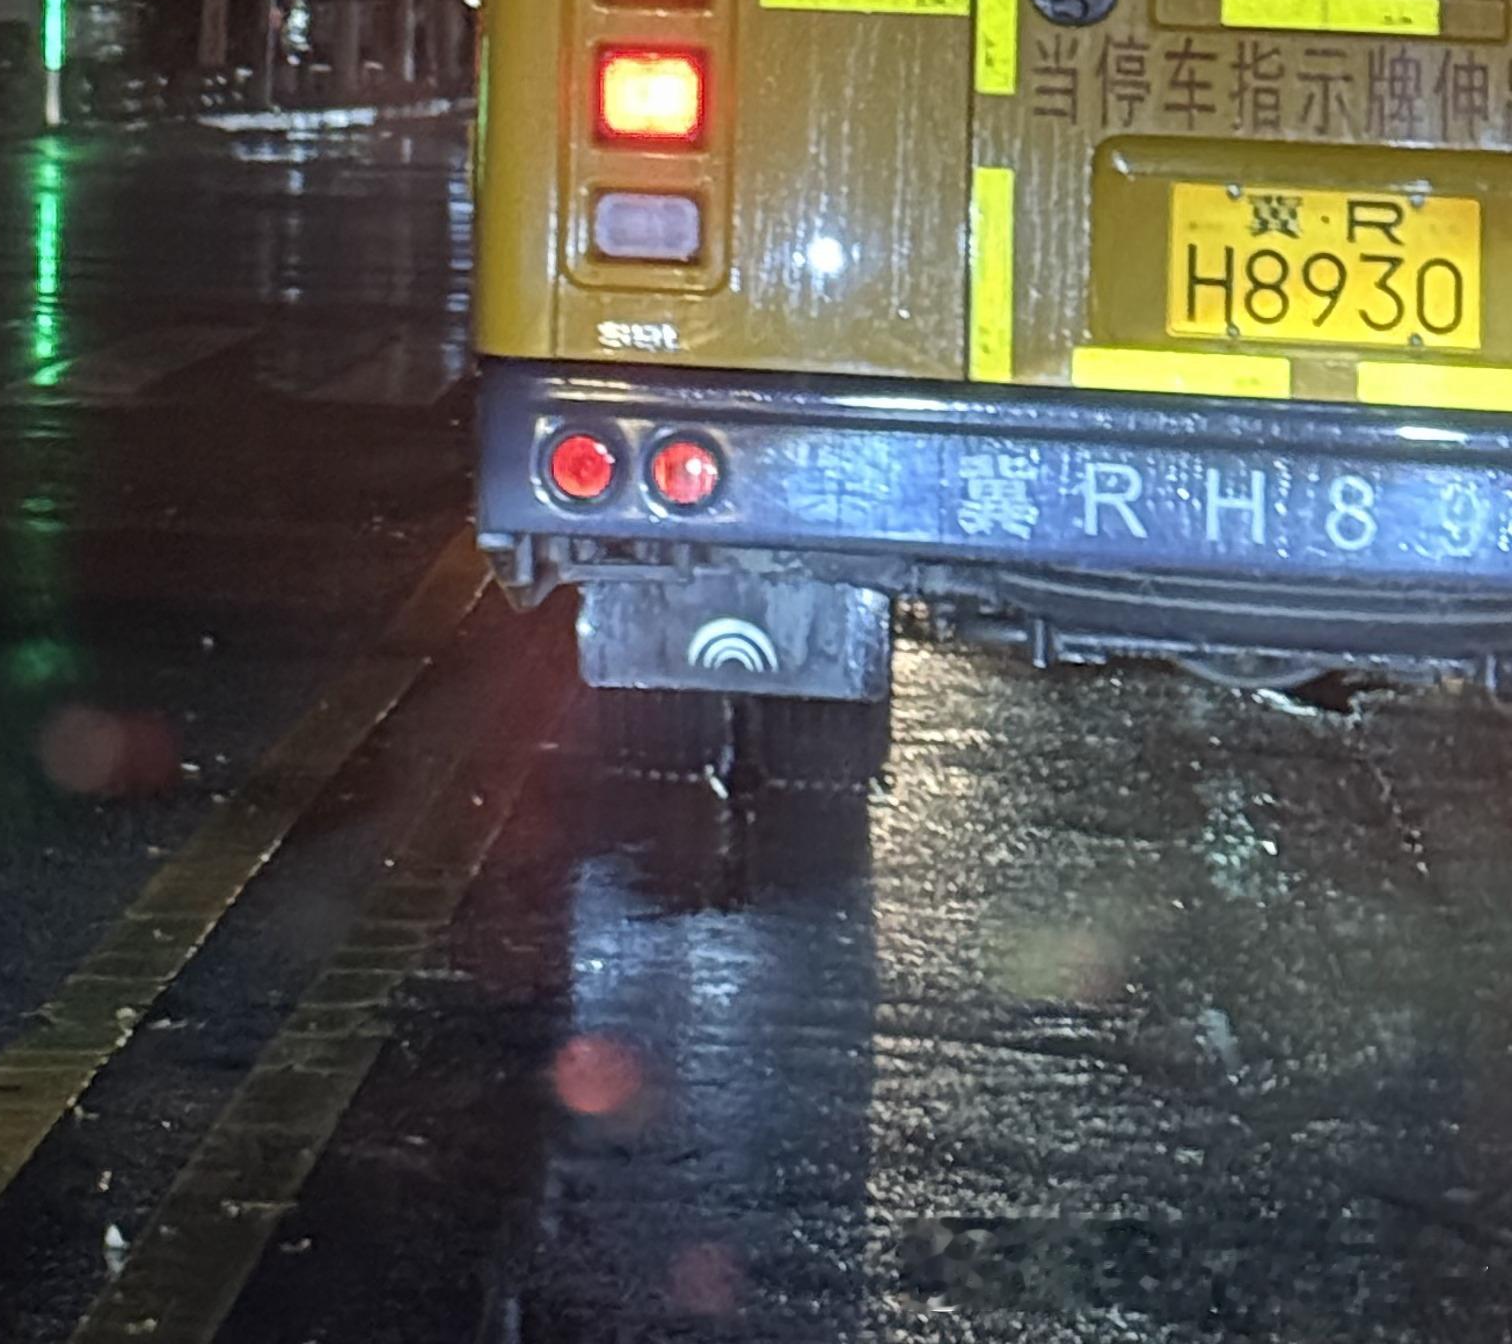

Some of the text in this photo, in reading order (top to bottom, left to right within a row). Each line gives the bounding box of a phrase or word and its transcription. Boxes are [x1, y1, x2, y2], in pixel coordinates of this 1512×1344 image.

[1032, 32, 1512, 142] 当停车指示牌伸
[1187, 243, 1464, 336] H8930
